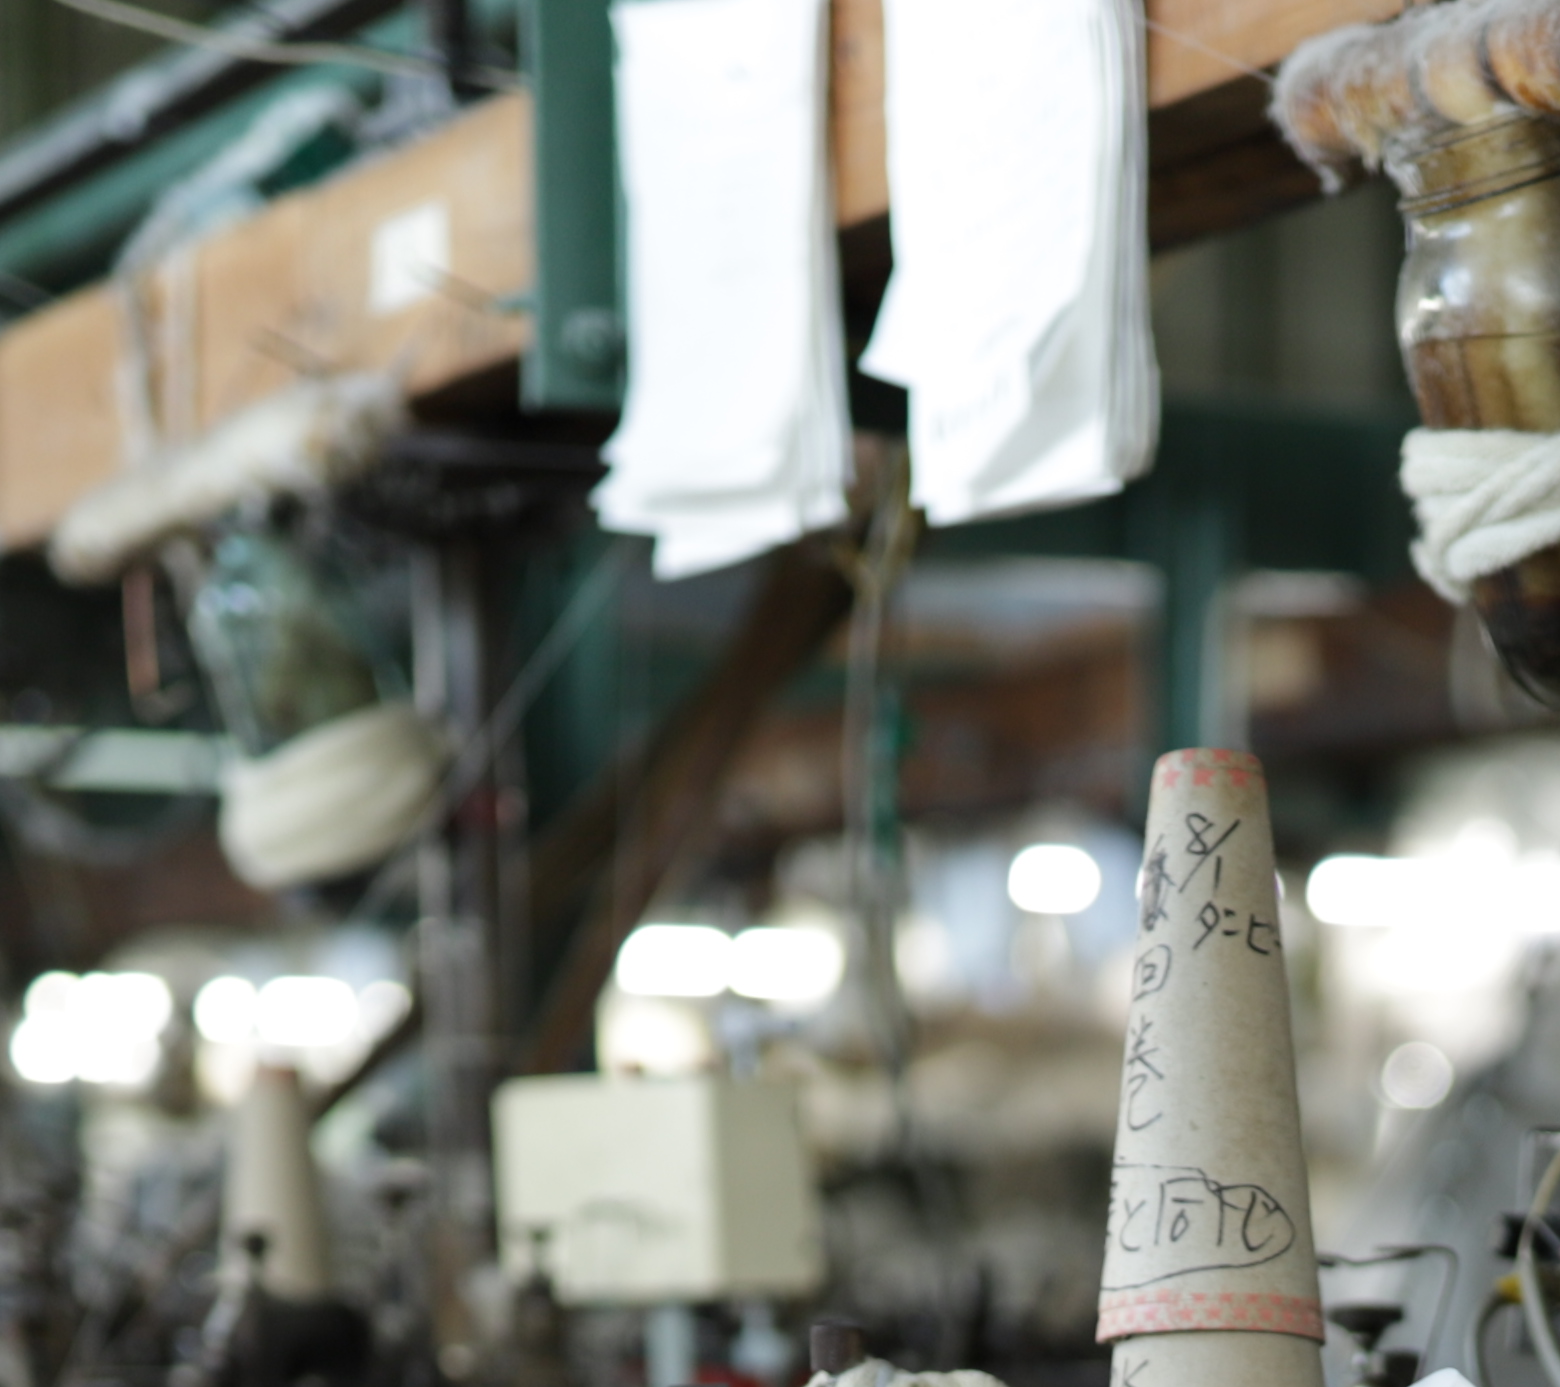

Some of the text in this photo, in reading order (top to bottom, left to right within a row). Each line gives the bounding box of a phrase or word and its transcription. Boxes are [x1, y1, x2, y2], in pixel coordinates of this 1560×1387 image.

[1178, 812, 1241, 897] 8/1
[1109, 1177, 1281, 1252] と同じ
